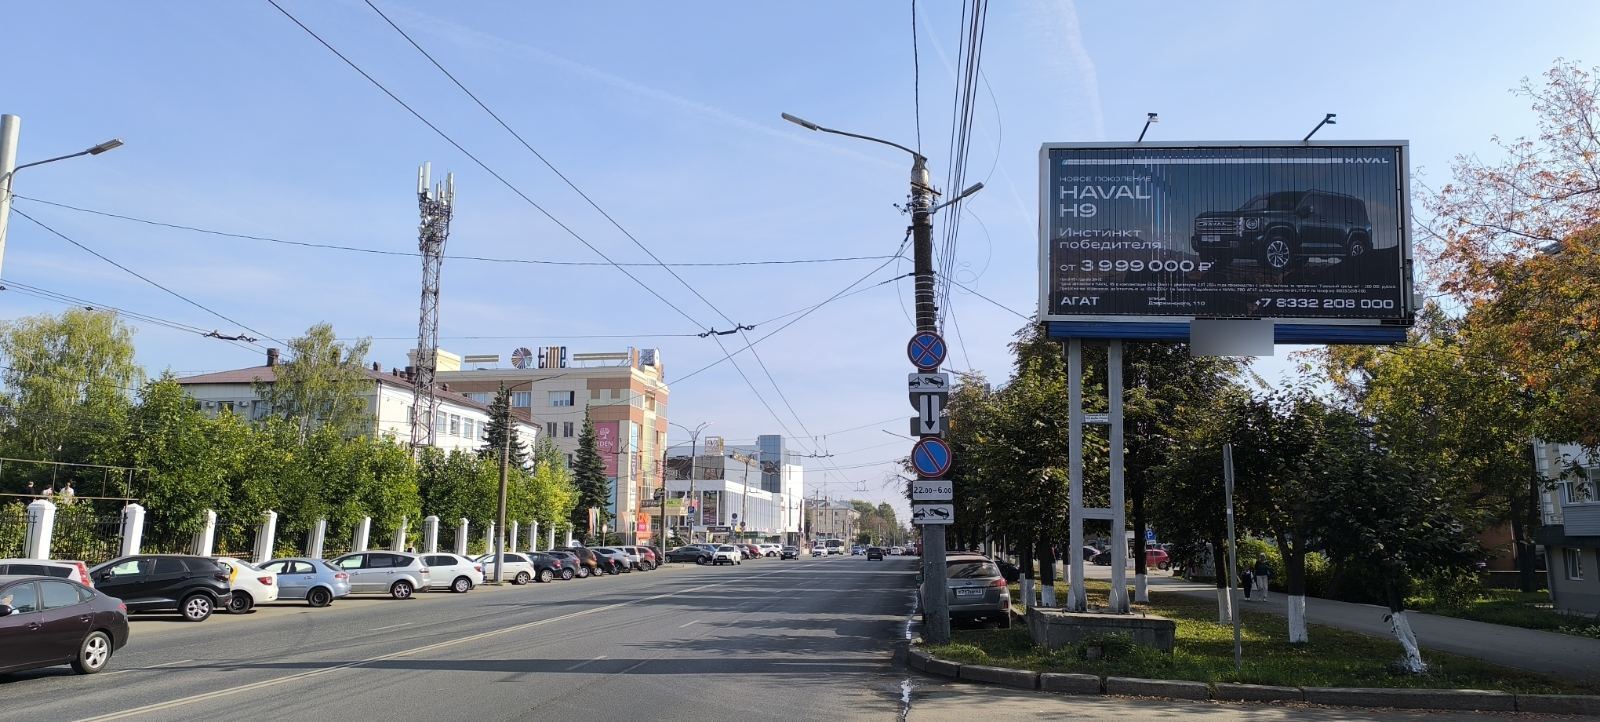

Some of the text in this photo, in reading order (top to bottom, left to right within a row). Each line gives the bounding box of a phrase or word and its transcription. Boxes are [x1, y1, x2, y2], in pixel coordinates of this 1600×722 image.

[1060, 185, 1151, 200] HAVAL
[1060, 203, 1097, 218] H9
[1060, 227, 1142, 237] Инстинкт
[1060, 239, 1161, 251] победителя
[1061, 296, 1100, 306] АГАТ
[1255, 298, 1394, 309] +7 8332 208 000
[538, 346, 567, 369] time
[913, 486, 952, 494] 22.00-6.00
